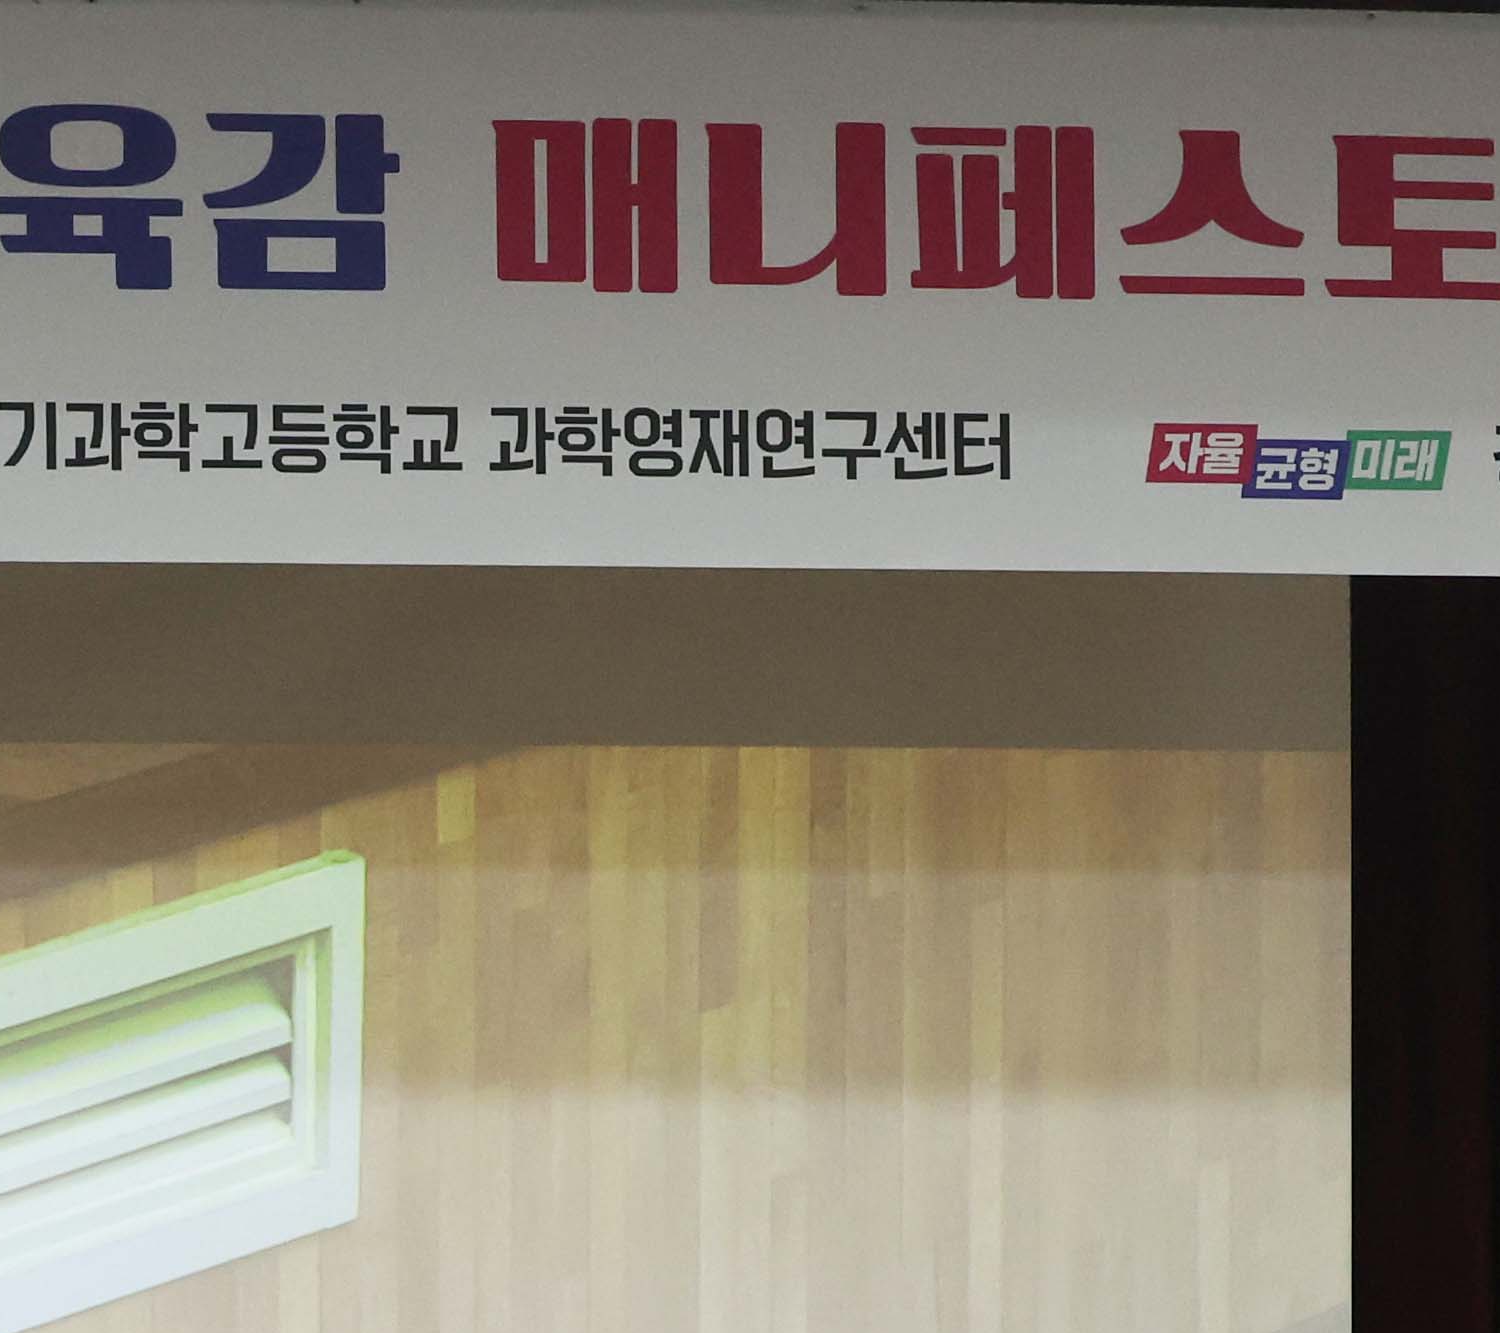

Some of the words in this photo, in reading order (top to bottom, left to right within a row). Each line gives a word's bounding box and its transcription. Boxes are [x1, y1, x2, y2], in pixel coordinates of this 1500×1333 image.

[490, 407, 1010, 480] 과학영재연구센터
[1159, 431, 1245, 475] 자율
[1255, 447, 1339, 492] 균형
[1351, 438, 1440, 482] 미래
